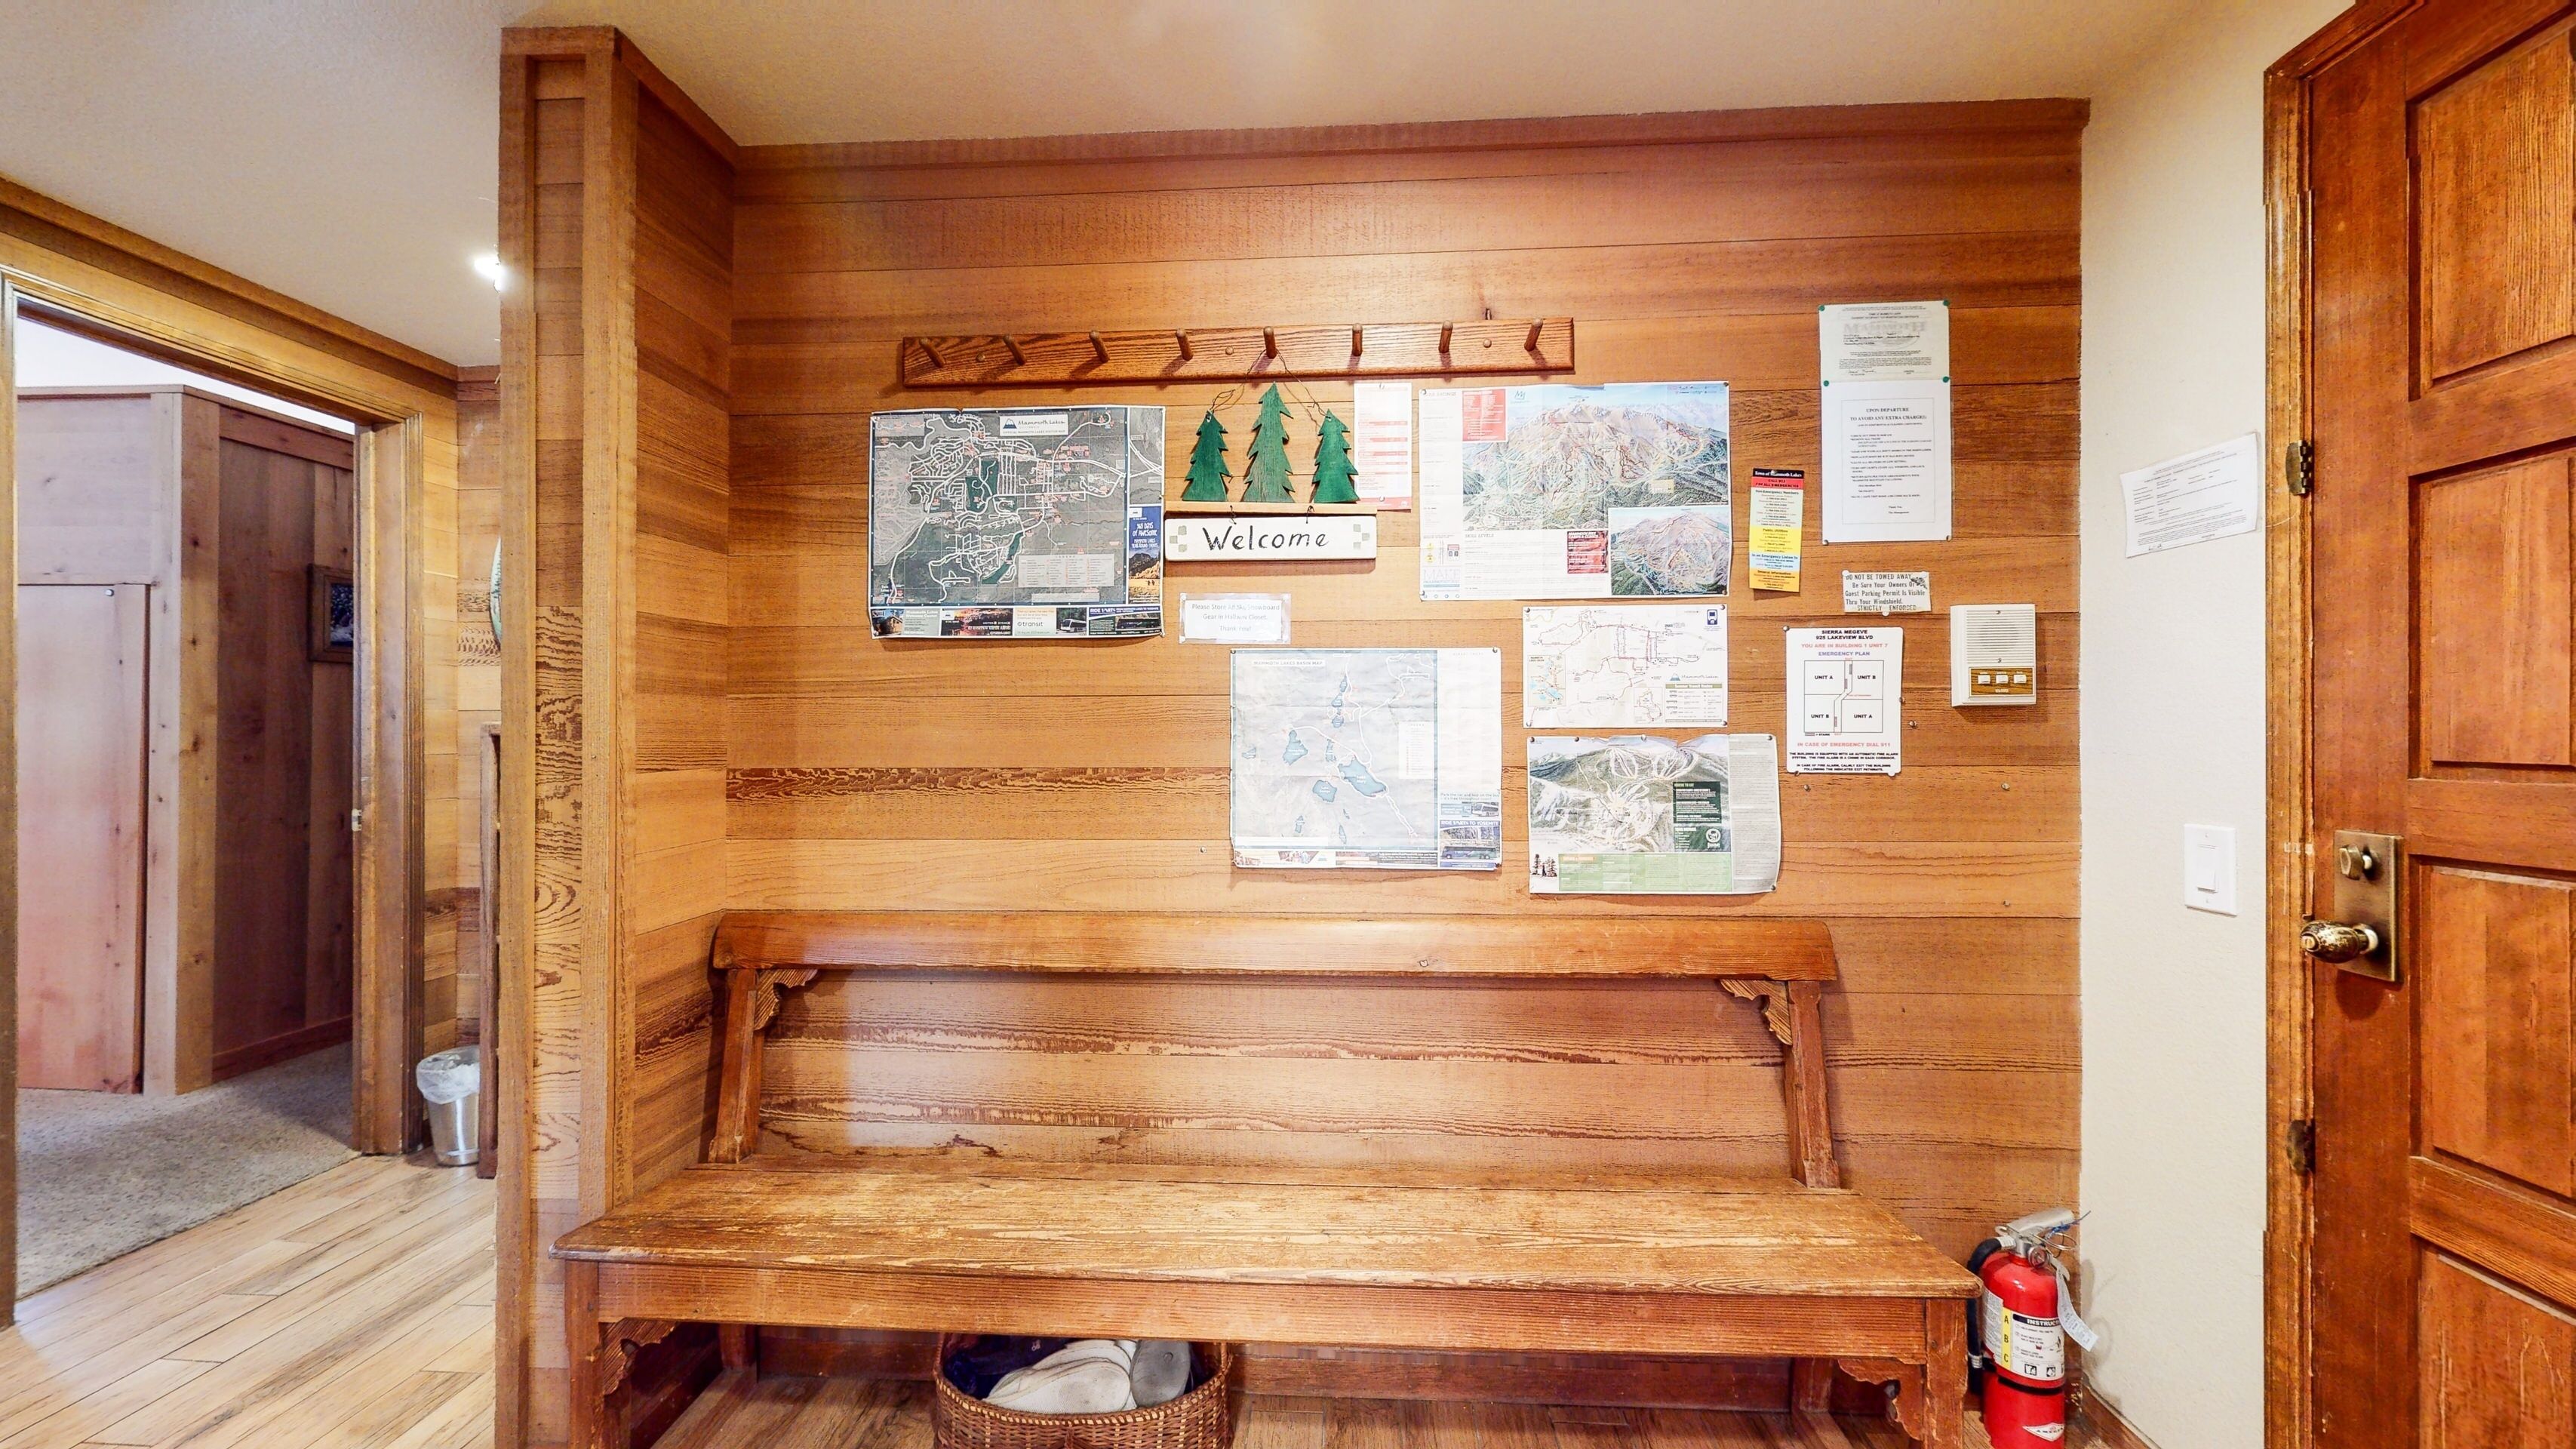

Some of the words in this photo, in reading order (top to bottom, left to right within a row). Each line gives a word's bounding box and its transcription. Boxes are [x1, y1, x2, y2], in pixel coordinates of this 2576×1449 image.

[1202, 525, 1329, 551] Welcome
[2004, 1315, 2009, 1324] A
[2004, 1334, 2009, 1343] B
[2004, 1354, 2009, 1362] C
